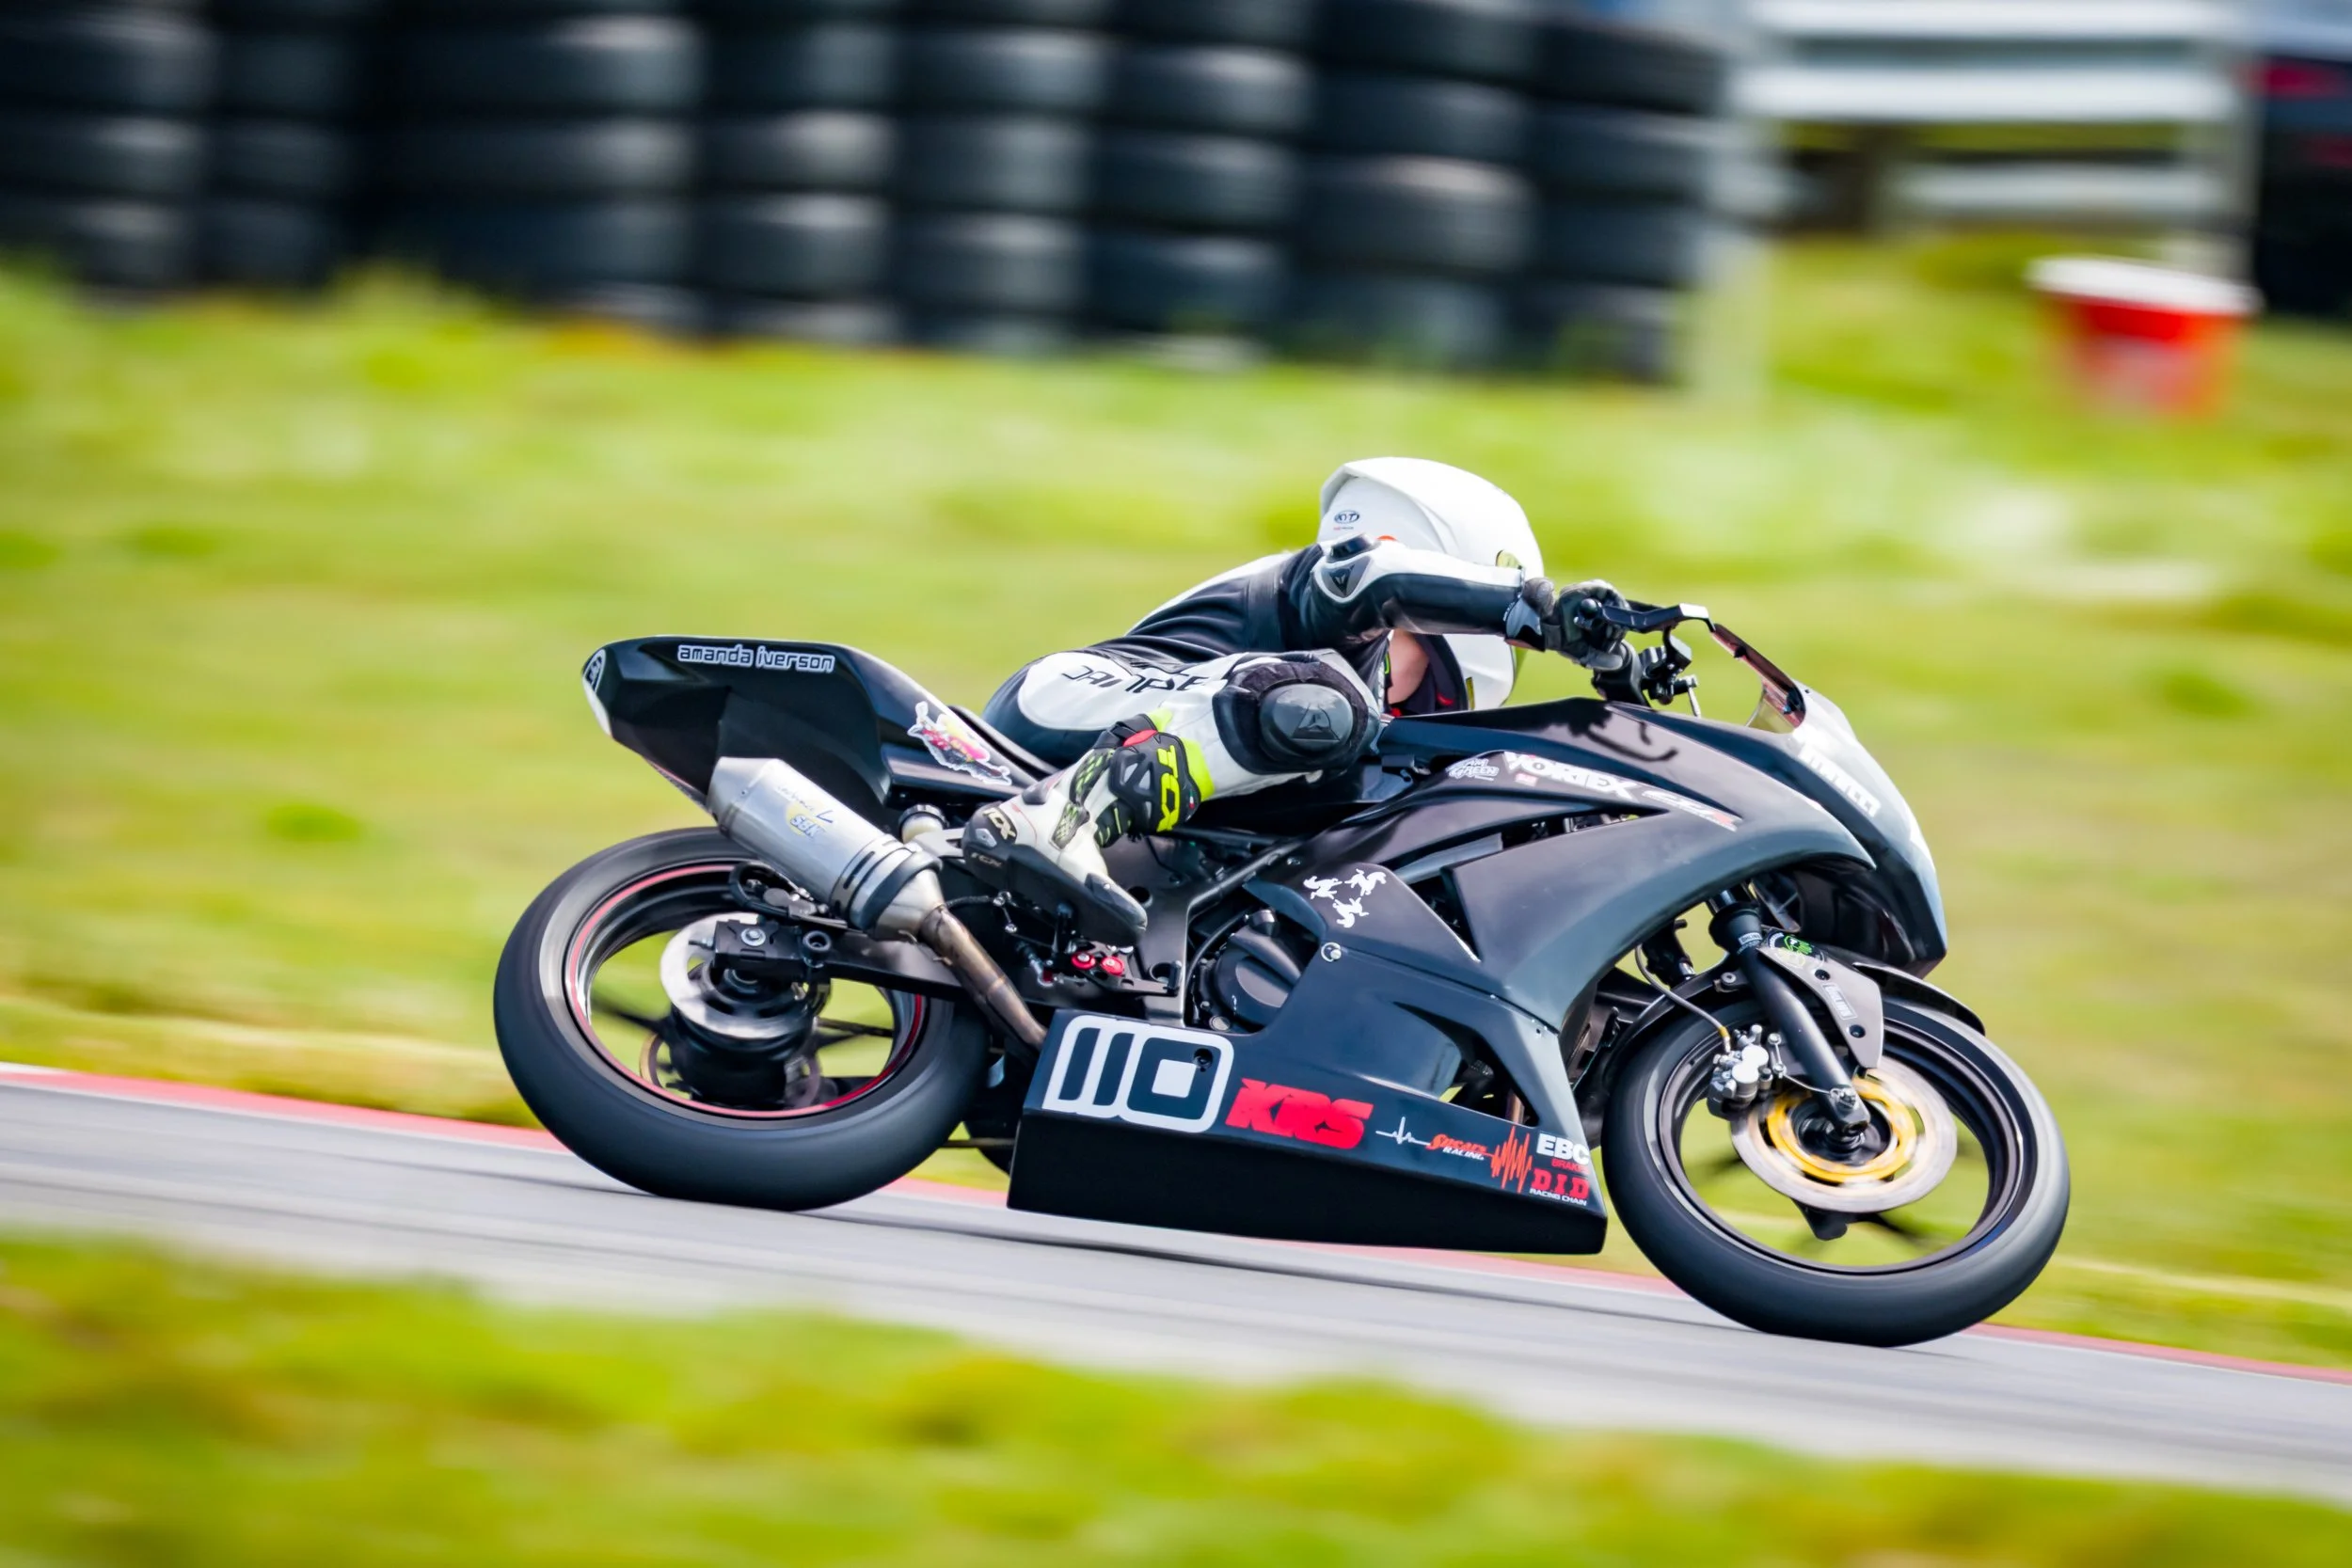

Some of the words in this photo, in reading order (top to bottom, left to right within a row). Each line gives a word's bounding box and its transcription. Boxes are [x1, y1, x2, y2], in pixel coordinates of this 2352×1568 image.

[678, 643, 753, 667] amanda
[756, 646, 834, 673] iverson
[1504, 752, 1638, 802] VORTEX
[1042, 1015, 1234, 1132] 110
[1226, 1077, 1375, 1149] KRS
[1536, 1133, 1590, 1165] EBC
[1530, 1188, 1561, 1200] RACING
[1562, 1195, 1588, 1207] CHAIN
